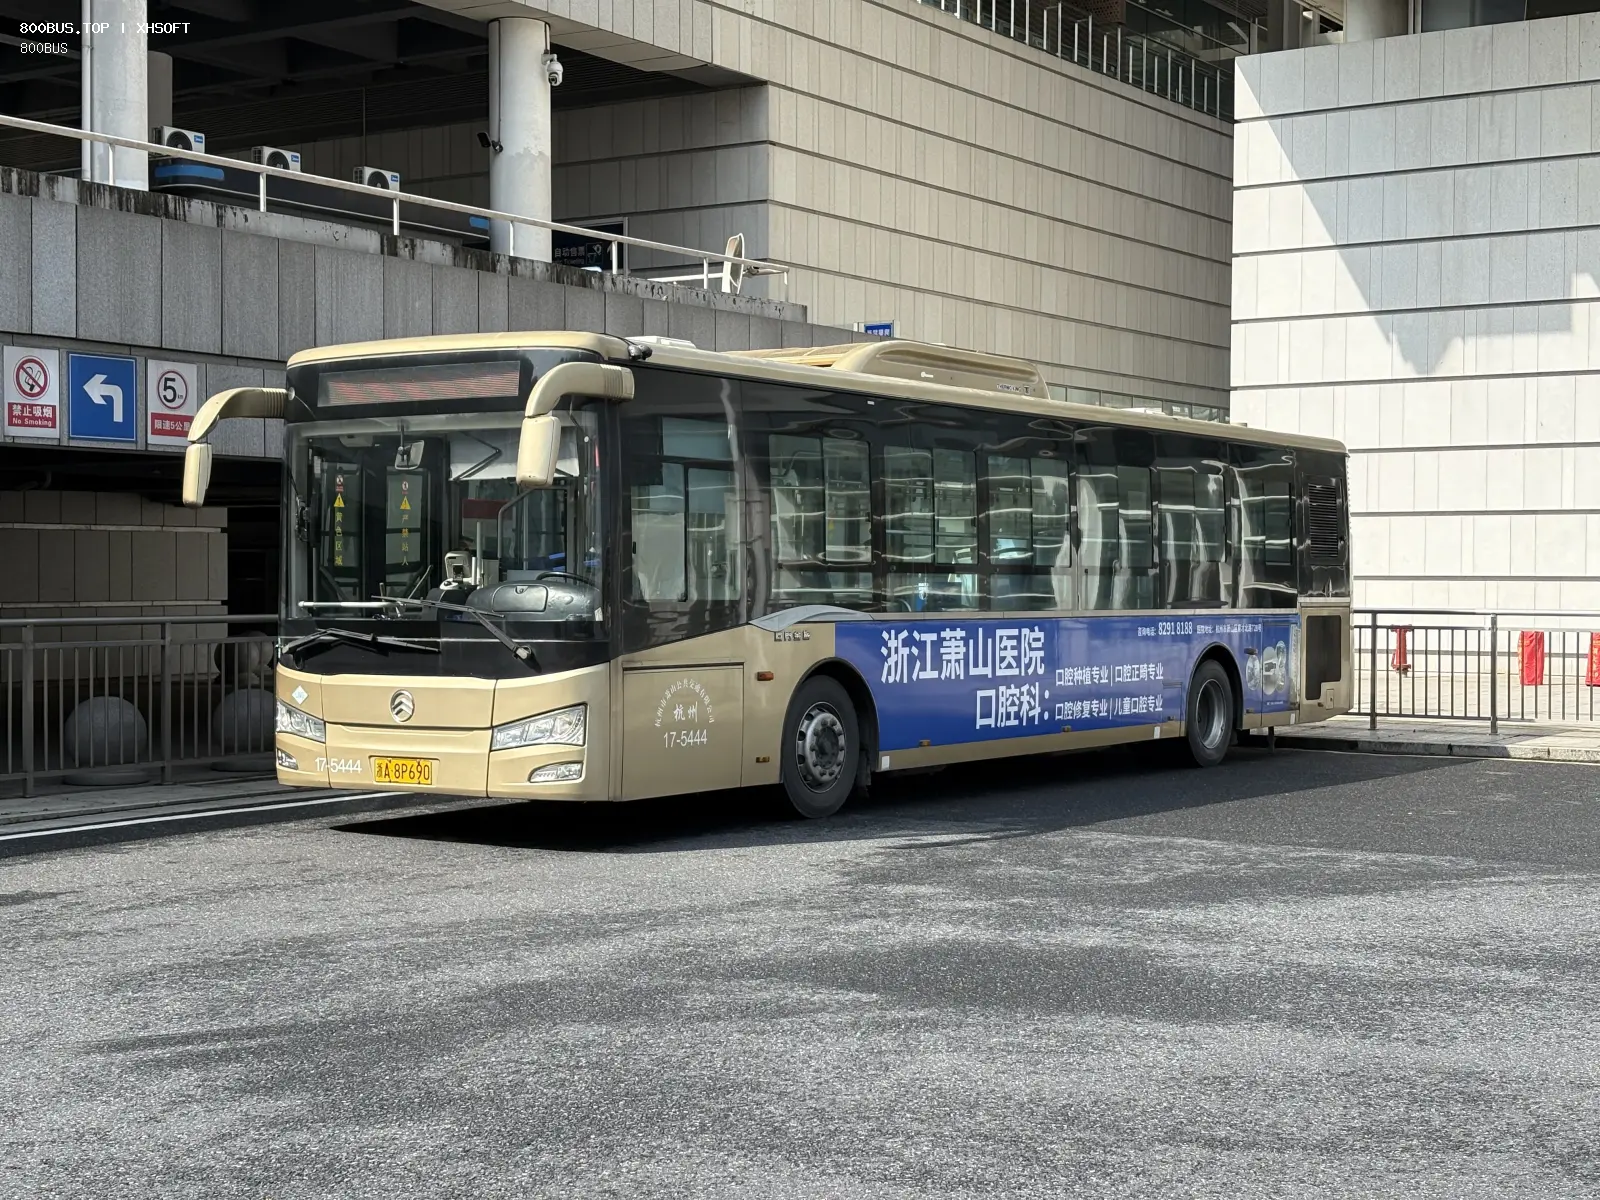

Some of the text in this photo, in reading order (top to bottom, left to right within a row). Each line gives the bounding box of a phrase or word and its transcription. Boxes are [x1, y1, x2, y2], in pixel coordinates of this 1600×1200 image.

[162, 377, 177, 403] 5
[12, 404, 53, 418] 禁止吸烟
[12, 417, 52, 428] No Smoking
[154, 419, 192, 432] 限速5公里
[1158, 621, 1175, 636] 8291
[1176, 621, 1193, 635] 8188
[881, 626, 1045, 684] 浙江萧山医院
[1055, 665, 1109, 687] 口腔种植专业
[1115, 662, 1164, 683] 口腔正畸专业
[673, 701, 698, 722] 杭州
[975, 682, 1050, 730] 口腔科：
[1055, 698, 1108, 720] 口腔修复专业
[1114, 694, 1163, 716] 儿童口腔专业
[664, 729, 708, 748] 17-5444
[315, 757, 363, 773] 17-5444
